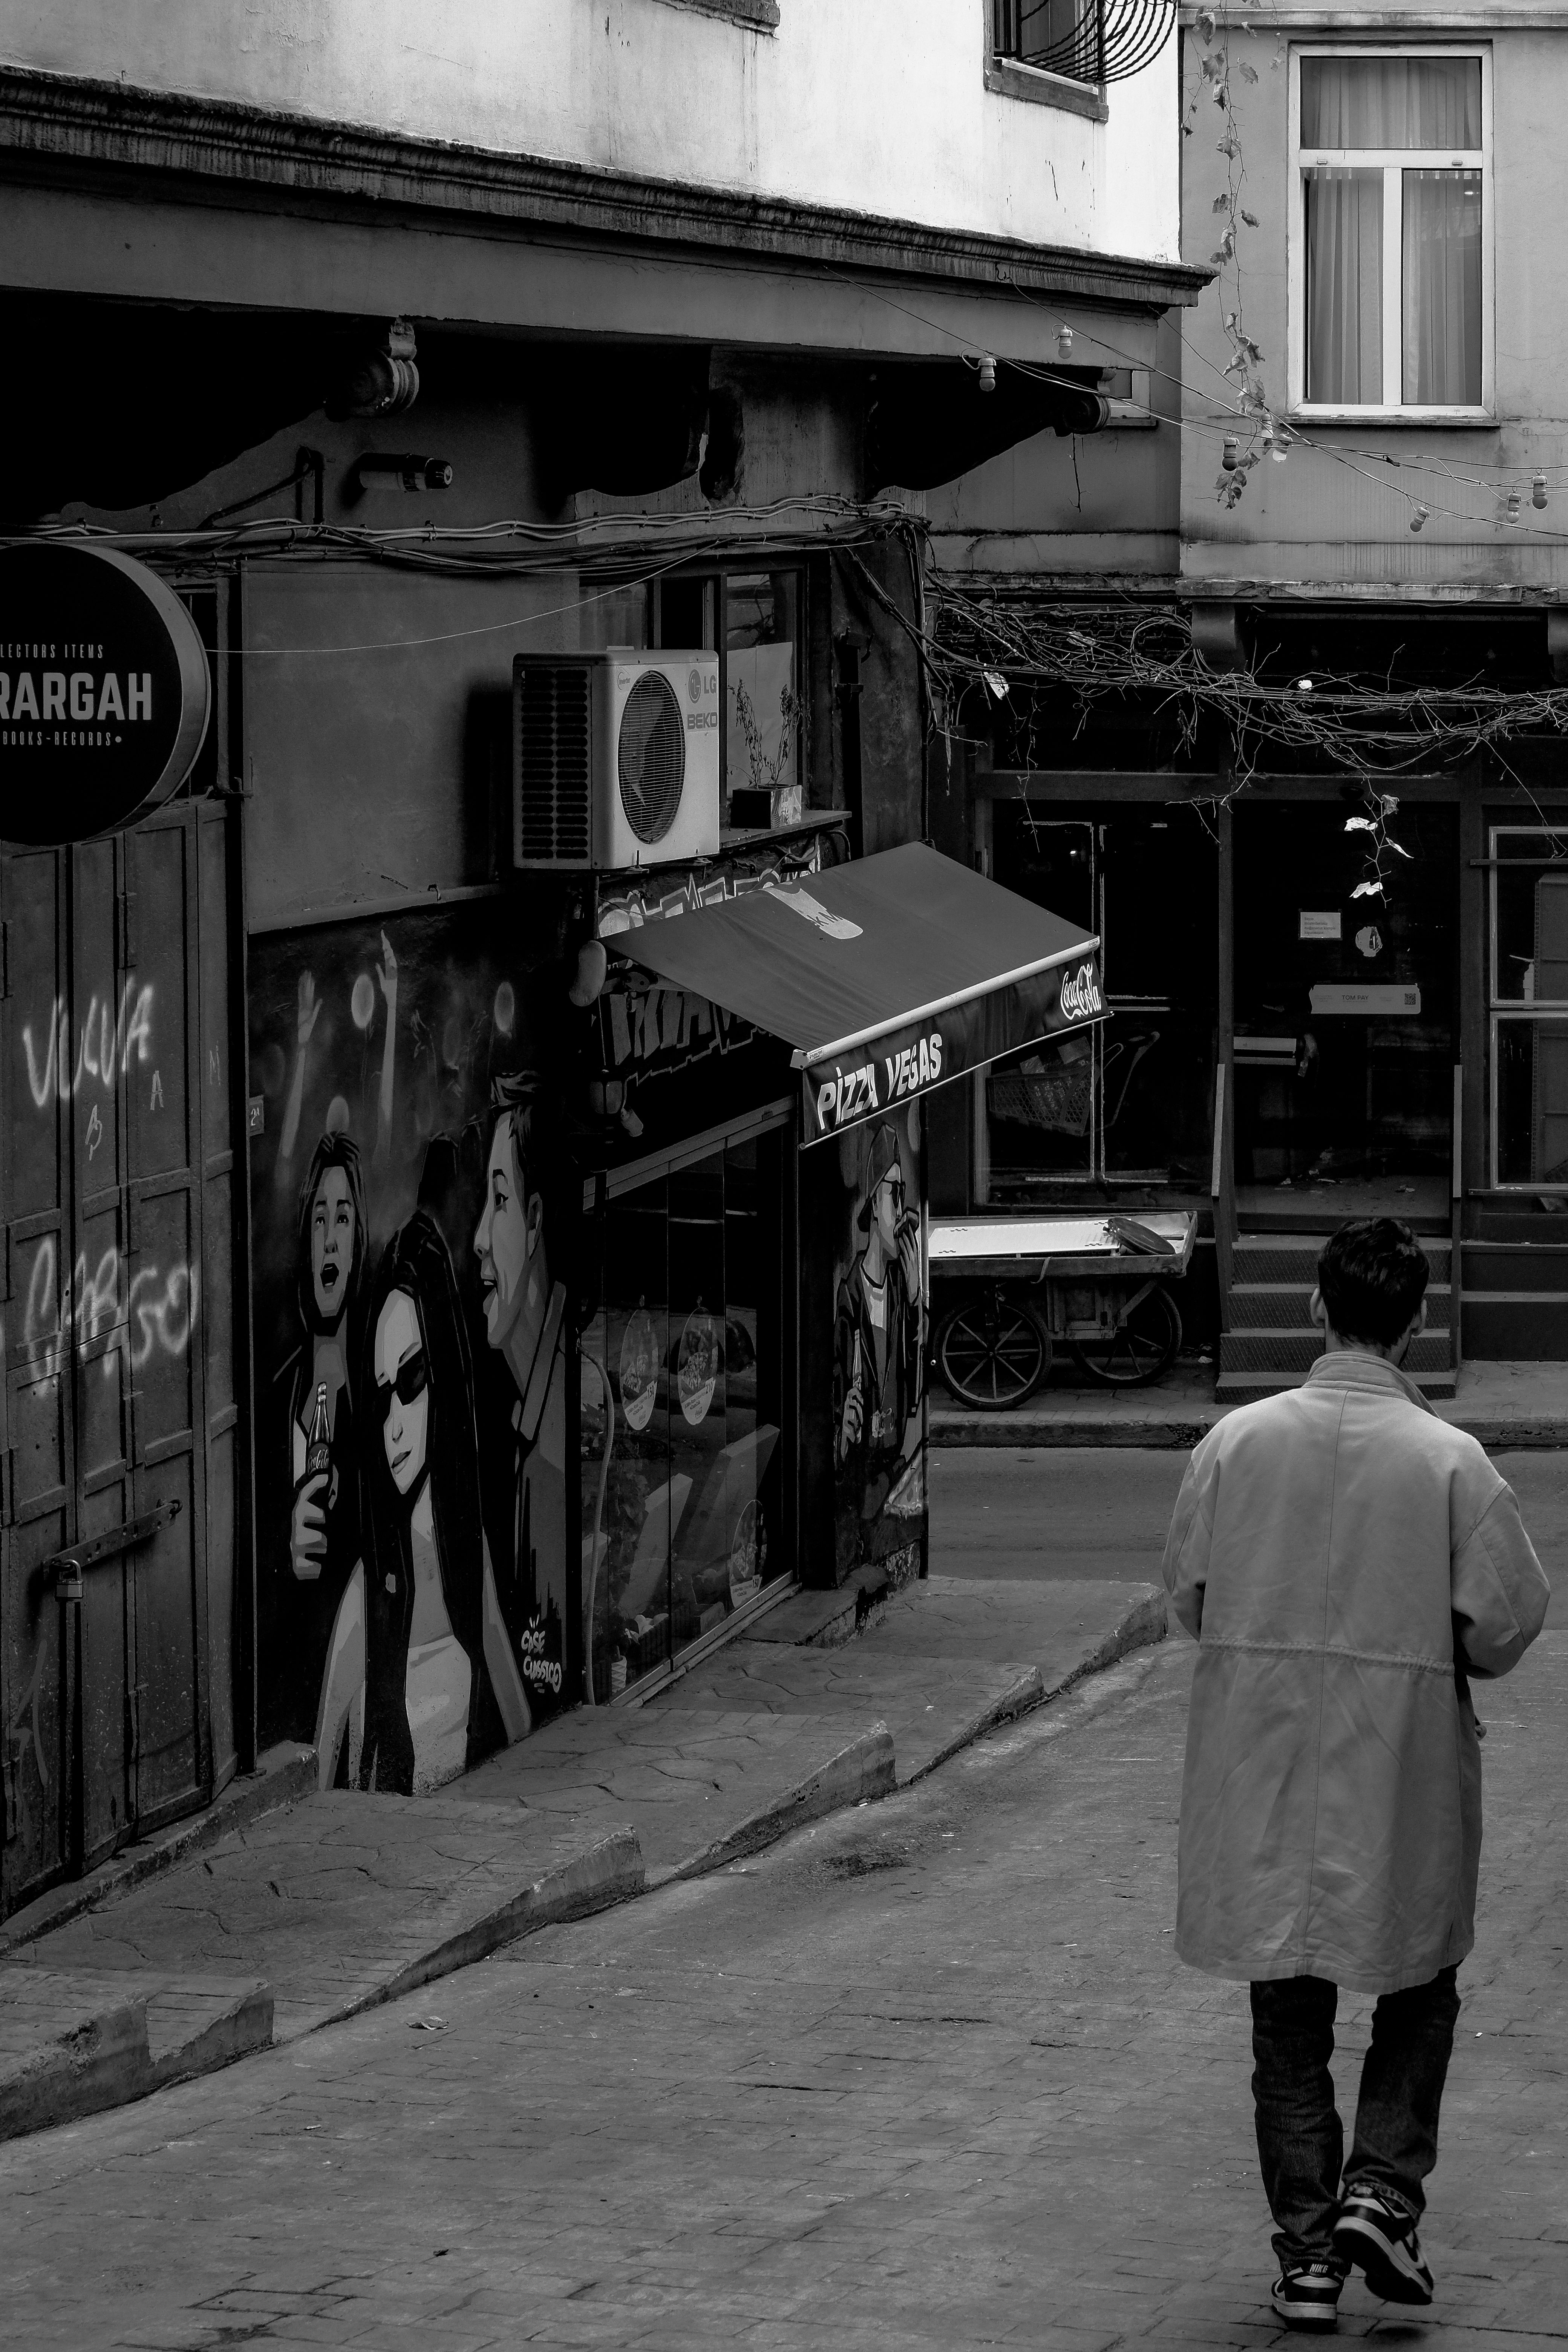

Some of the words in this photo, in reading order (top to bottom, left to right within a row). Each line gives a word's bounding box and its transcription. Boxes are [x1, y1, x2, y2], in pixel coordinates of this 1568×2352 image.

[65, 644, 104, 659] ITEMS
[704, 675, 717, 694] LG
[687, 712, 718, 730] BEKO
[885, 1034, 943, 1100] VEGAS
[1309, 2263, 1328, 2273] NIKE
